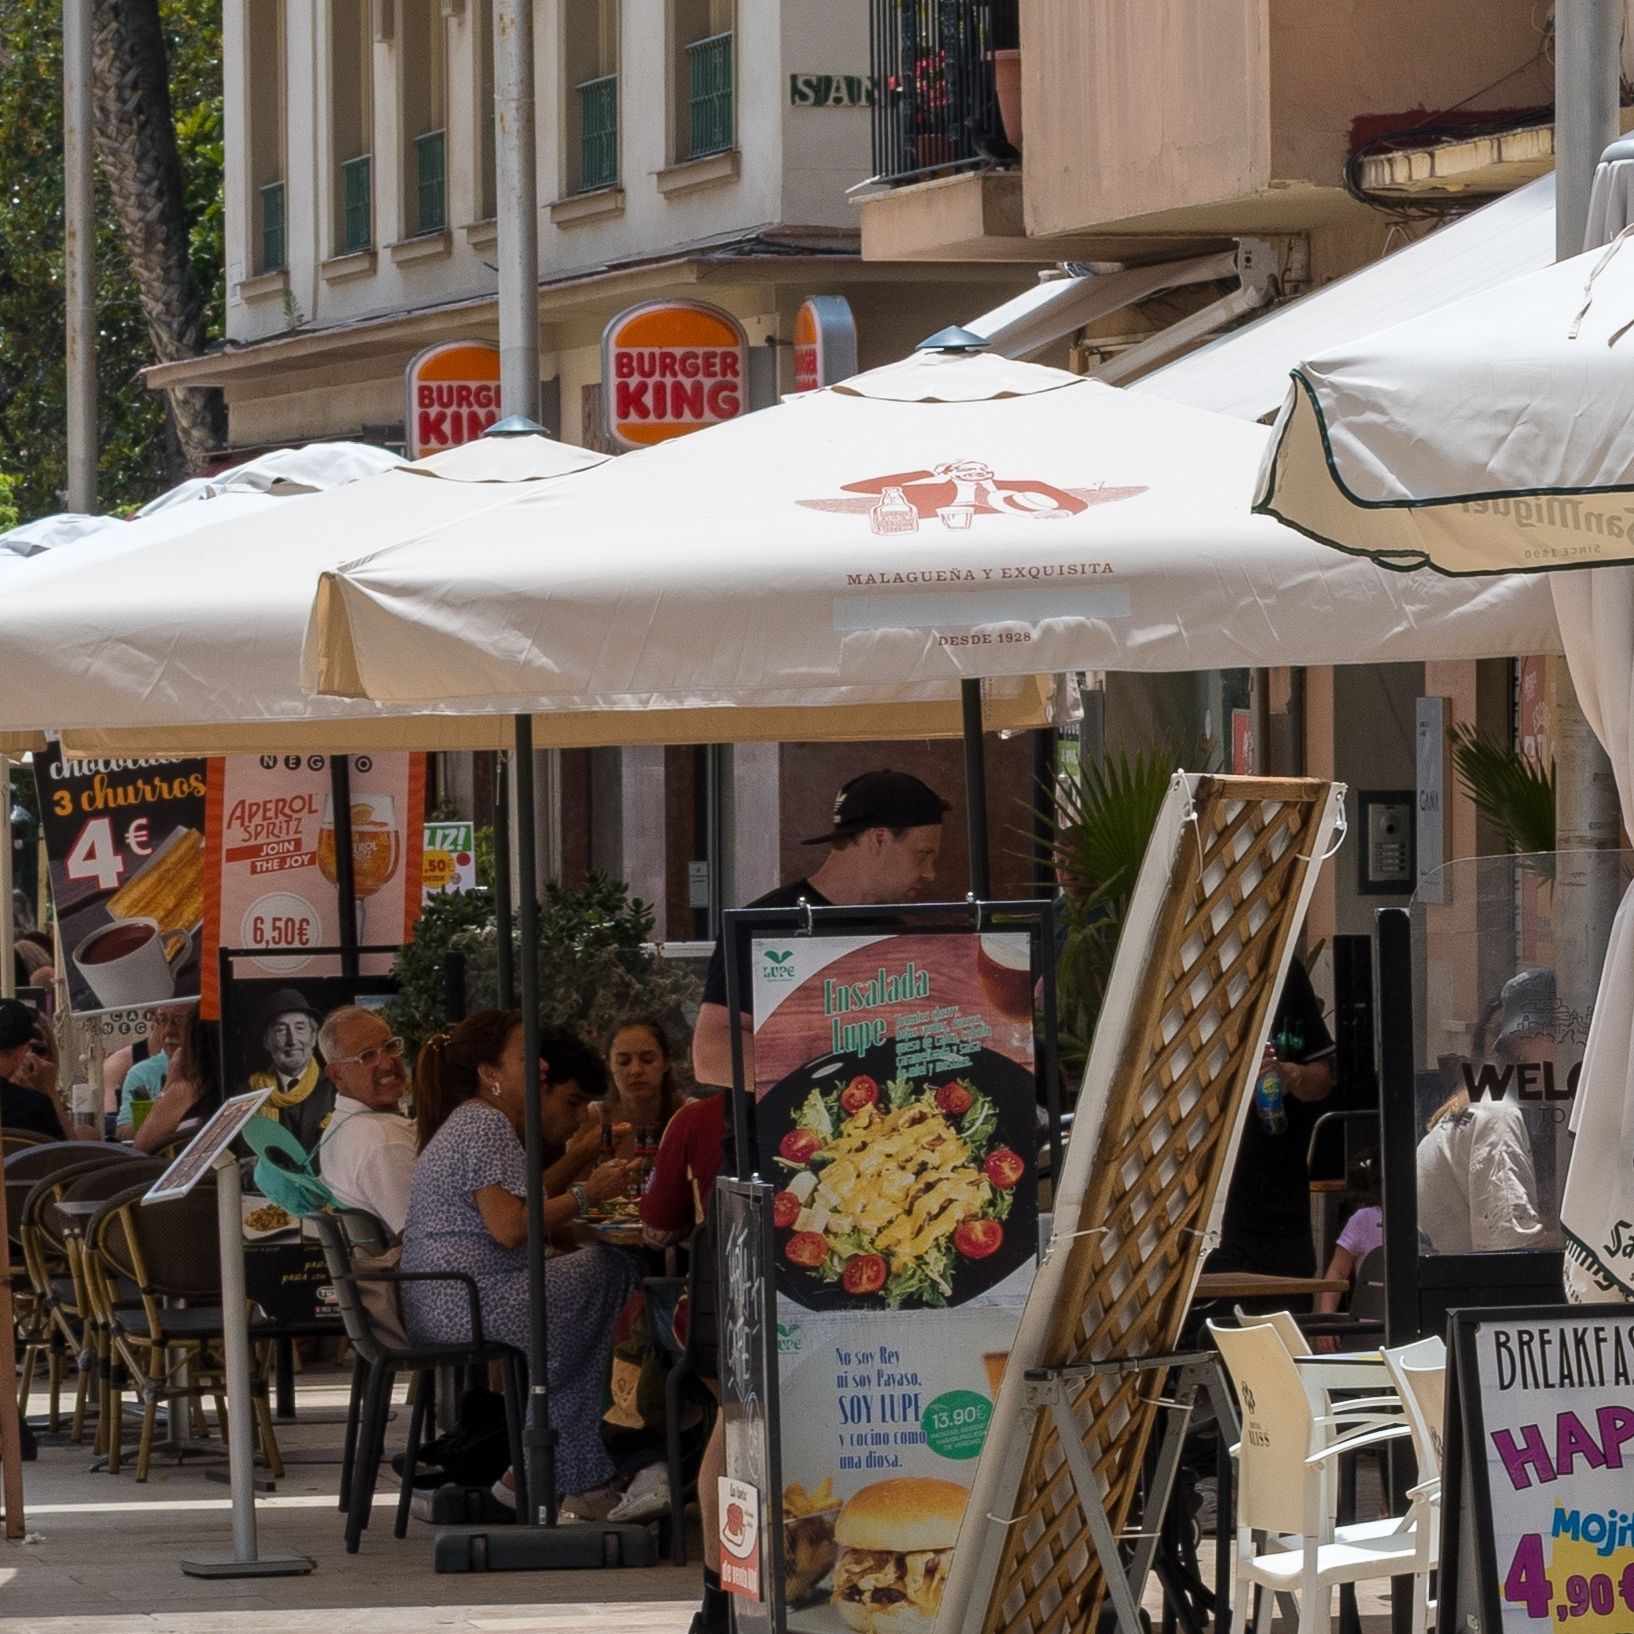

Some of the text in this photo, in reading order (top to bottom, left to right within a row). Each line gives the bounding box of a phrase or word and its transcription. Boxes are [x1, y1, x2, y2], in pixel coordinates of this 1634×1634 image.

[615, 350, 739, 379] BURGER
[418, 385, 500, 410] BURG
[615, 381, 741, 420] KING
[418, 412, 500, 446] KIN
[846, 562, 1115, 585] MALAGUEÑA Y EXQUISITA
[938, 631, 1031, 647] DESDE 1928
[262, 755, 371, 772] NEGO
[53, 773, 207, 816] 3 churros
[226, 794, 319, 830] APEROL
[260, 841, 295, 857] JOIN
[255, 854, 311, 873] THE JOY
[253, 915, 311, 948] 6,50€
[824, 962, 929, 1016] Ensalada
[832, 1017, 887, 1058] Lupe
[1538, 1107, 1566, 1124] TO
[836, 1346, 900, 1369] No soy Rey
[837, 1371, 848, 1388] ni
[852, 1373, 872, 1390] soy
[838, 1393, 922, 1425] SOY LUPE
[839, 1433, 845, 1448] y
[850, 1429, 890, 1447] cocino
[894, 1430, 927, 1446] como
[840, 1451, 902, 1469] una diosa.
